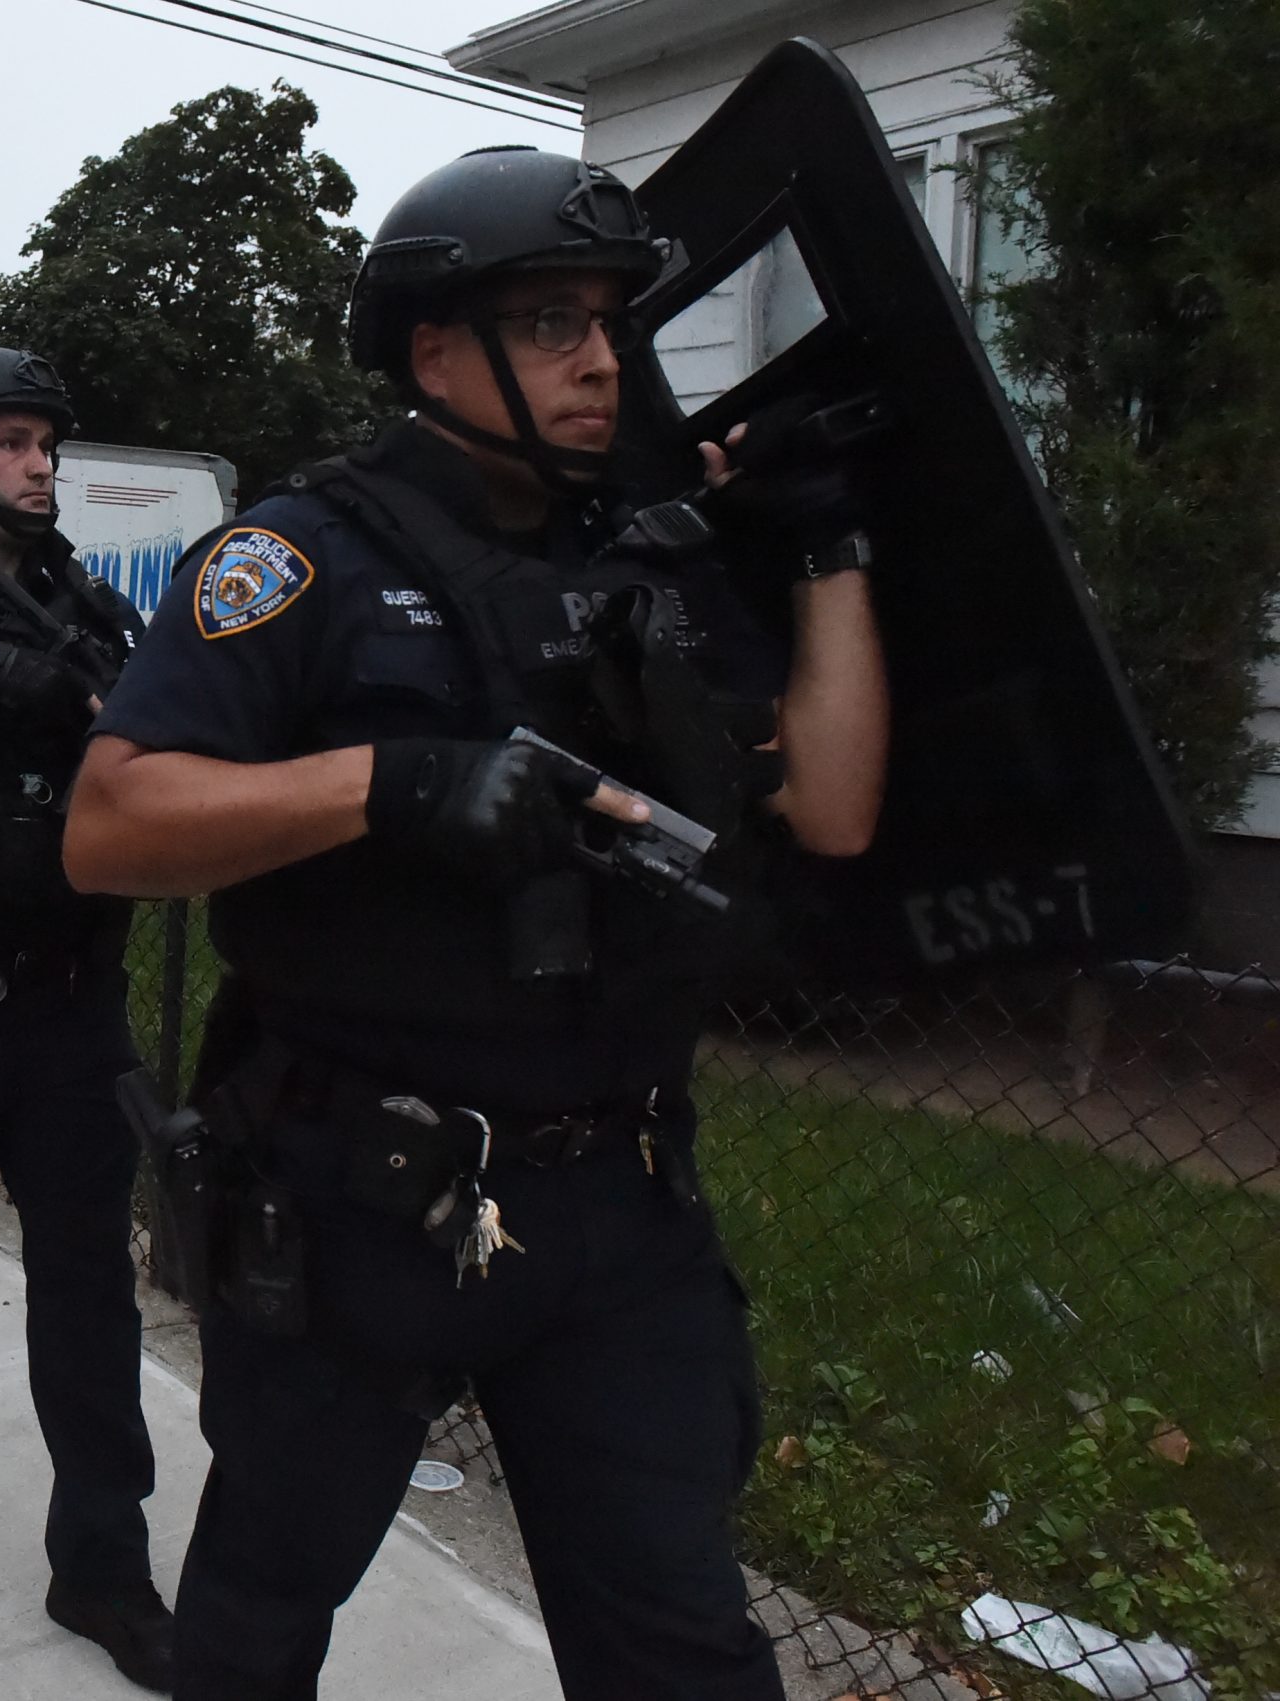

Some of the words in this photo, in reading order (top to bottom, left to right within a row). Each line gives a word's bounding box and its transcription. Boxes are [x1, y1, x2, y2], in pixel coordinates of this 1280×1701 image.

[248, 533, 292, 562] POLICE
[221, 541, 298, 584] DEPARTMENT
[203, 564, 217, 592] CITY
[201, 595, 211, 612] OF
[220, 613, 249, 629] NEW
[251, 592, 286, 617] YORK
[406, 610, 443, 626] 7483
